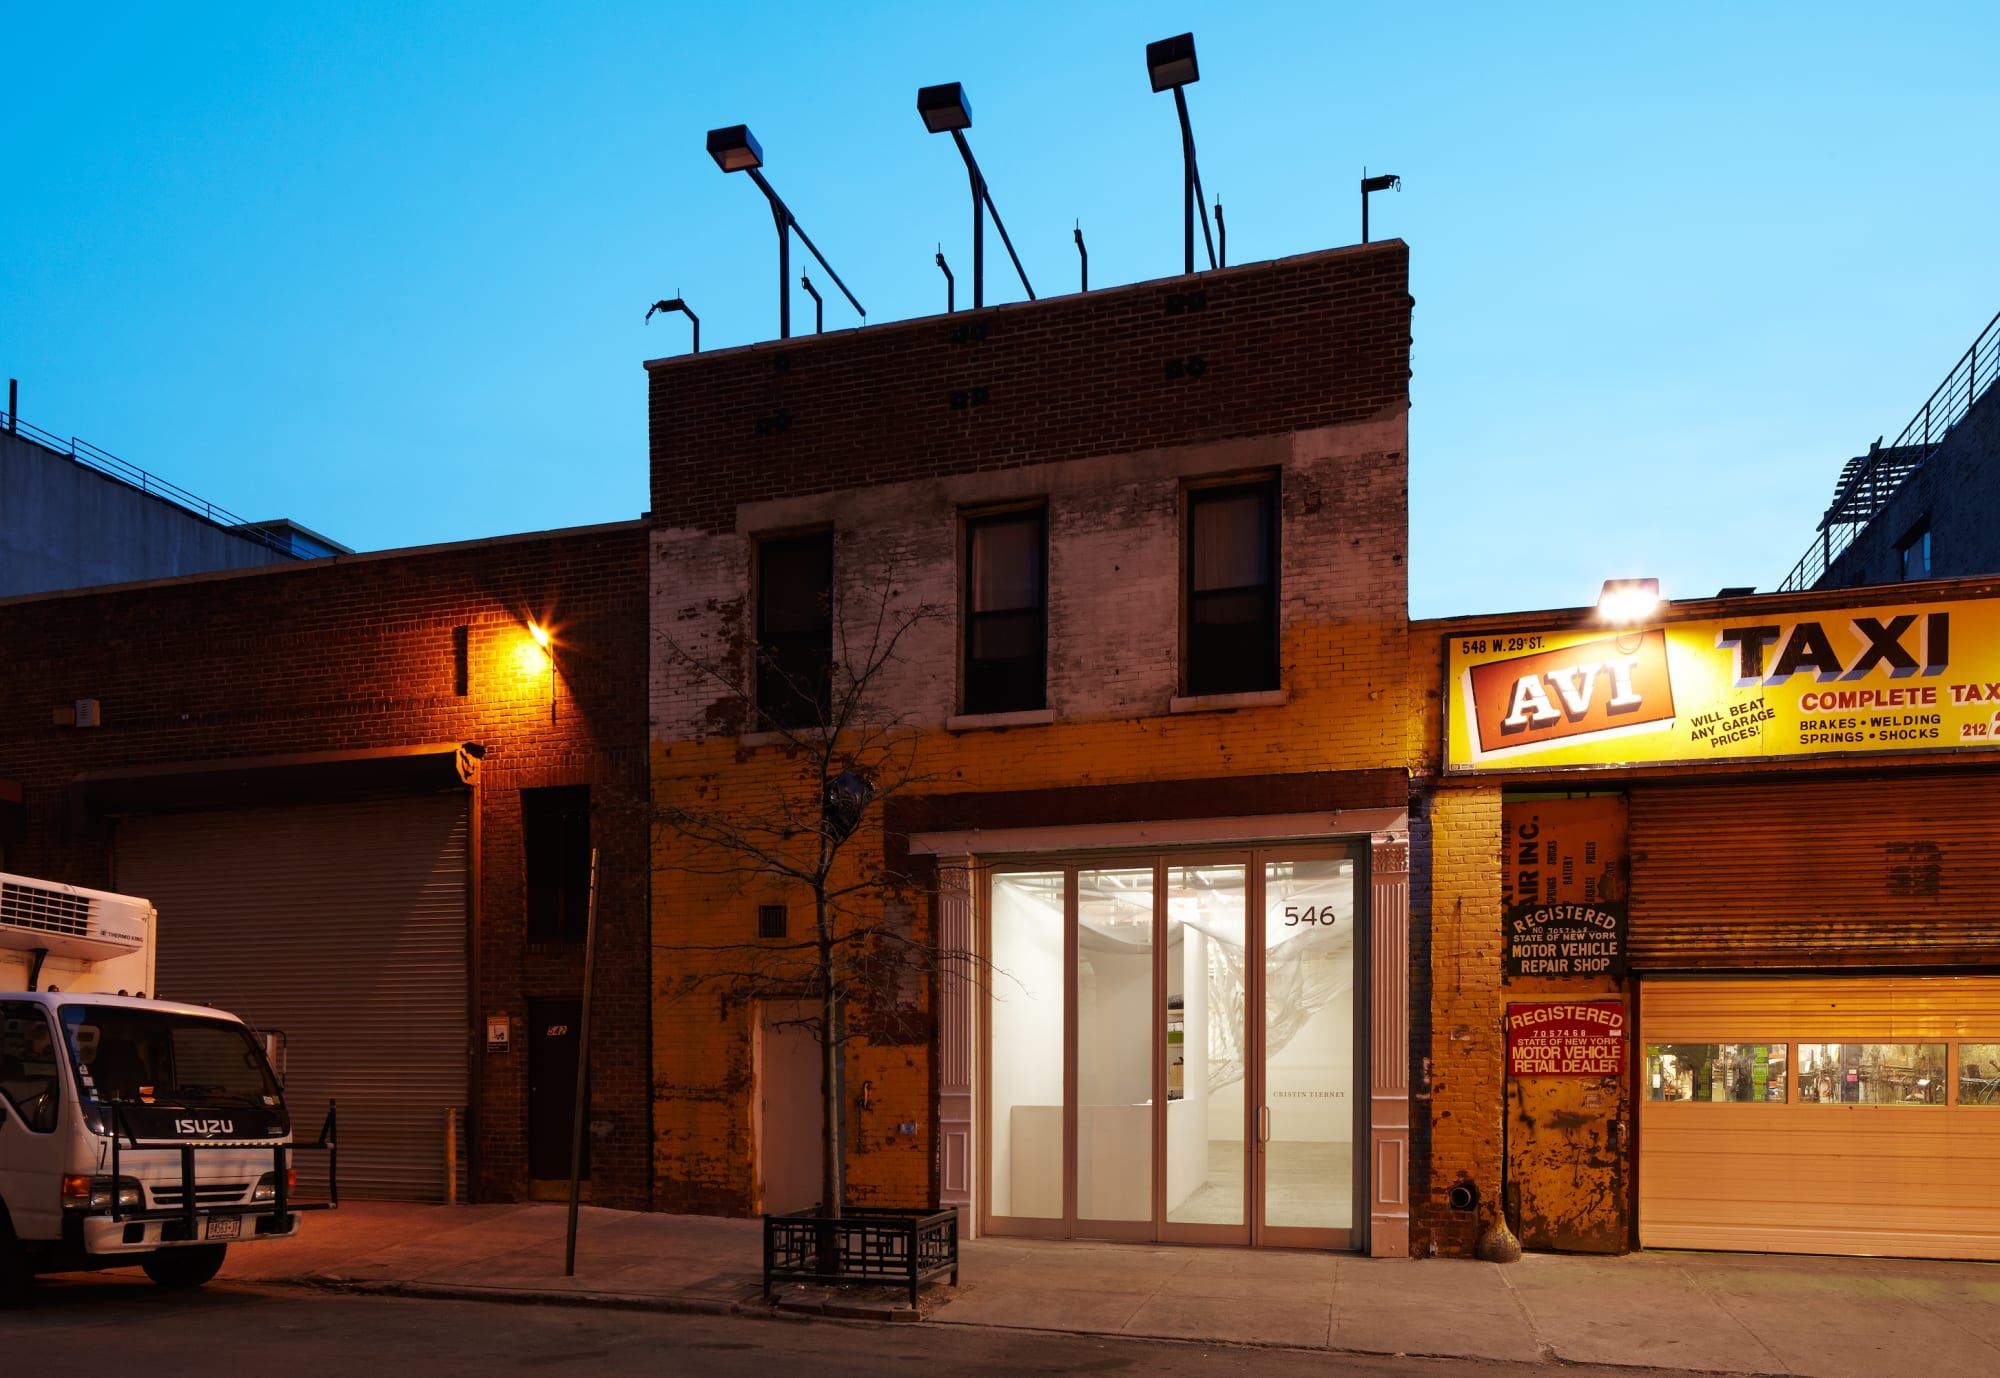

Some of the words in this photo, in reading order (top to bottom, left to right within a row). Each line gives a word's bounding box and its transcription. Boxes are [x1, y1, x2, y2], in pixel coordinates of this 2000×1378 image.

[1462, 640, 1487, 654] 548
[1493, 639, 1506, 652] W.
[1529, 636, 1545, 649] ST.
[1717, 612, 1949, 687] TAXI
[1502, 656, 1642, 735] AVI
[1801, 686, 1937, 711] COMPLETE
[1690, 711, 1724, 727] WILL
[1729, 697, 1765, 717] BEAT
[1691, 725, 1715, 741] ANY
[1722, 708, 1776, 731] GARAGE
[1799, 718, 1857, 731] BRAKES
[1870, 714, 1941, 727] WELDING
[1711, 725, 1760, 748] PRICES!
[1799, 732, 1864, 745] SPRINGS
[1879, 728, 1940, 741] SHOCKS
[1518, 815, 1539, 864] INC.
[1284, 905, 1336, 926] 546
[1513, 905, 1616, 933] REGISTERED
[1513, 934, 1543, 942] STATE
[1546, 933, 1560, 942] OF
[1563, 932, 1585, 941] NEW
[1588, 932, 1617, 940] YORK
[1512, 943, 1557, 958] MOTOR
[1561, 942, 1618, 957] VEHICLE
[1521, 959, 1569, 973] REPAIR
[1573, 958, 1610, 972] SHOP
[1510, 1006, 1623, 1029] REGISTERED
[1517, 1038, 1547, 1046] STATE
[1549, 1038, 1563, 1046] OF
[1590, 1037, 1618, 1045] YORK
[1512, 1046, 1560, 1060] MOTOR
[1564, 1045, 1621, 1059] VEHICLE
[1515, 1060, 1560, 1073] RETAIL
[1562, 1060, 1619, 1073] DEALER
[174, 1119, 234, 1134] ISUZU
